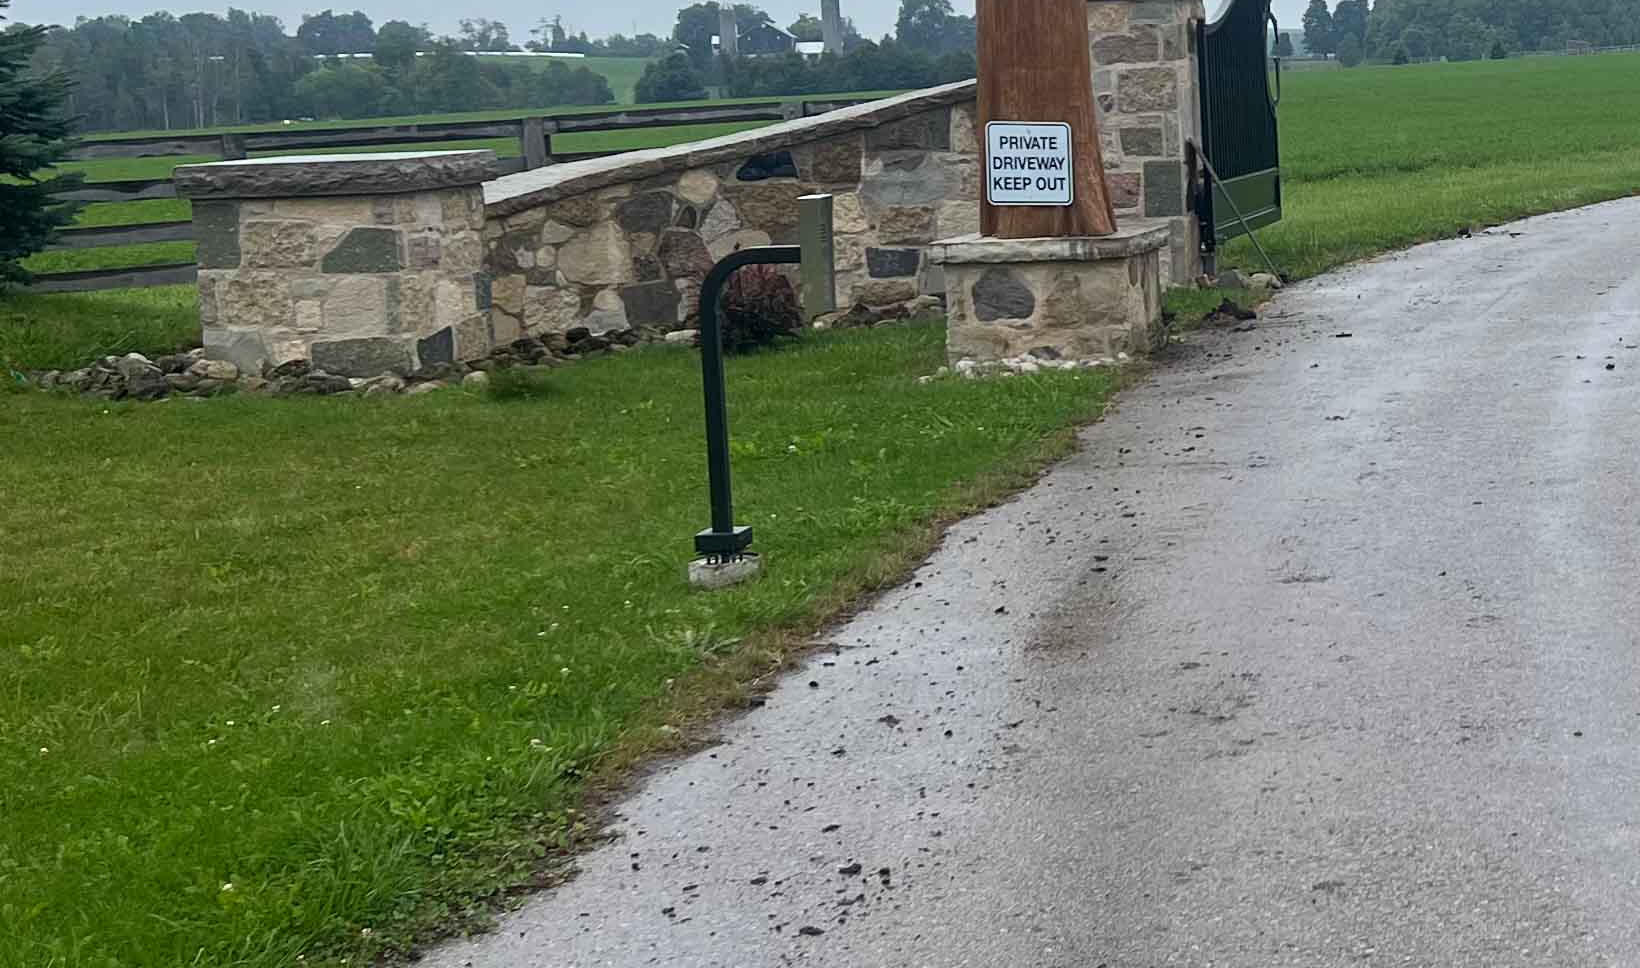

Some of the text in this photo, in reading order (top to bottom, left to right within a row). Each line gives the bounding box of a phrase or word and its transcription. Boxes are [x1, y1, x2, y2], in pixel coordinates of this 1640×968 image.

[999, 135, 1058, 150] PRIVATE
[992, 156, 1065, 170] DRIVEWAY
[993, 176, 1066, 191] KEEP OUT
